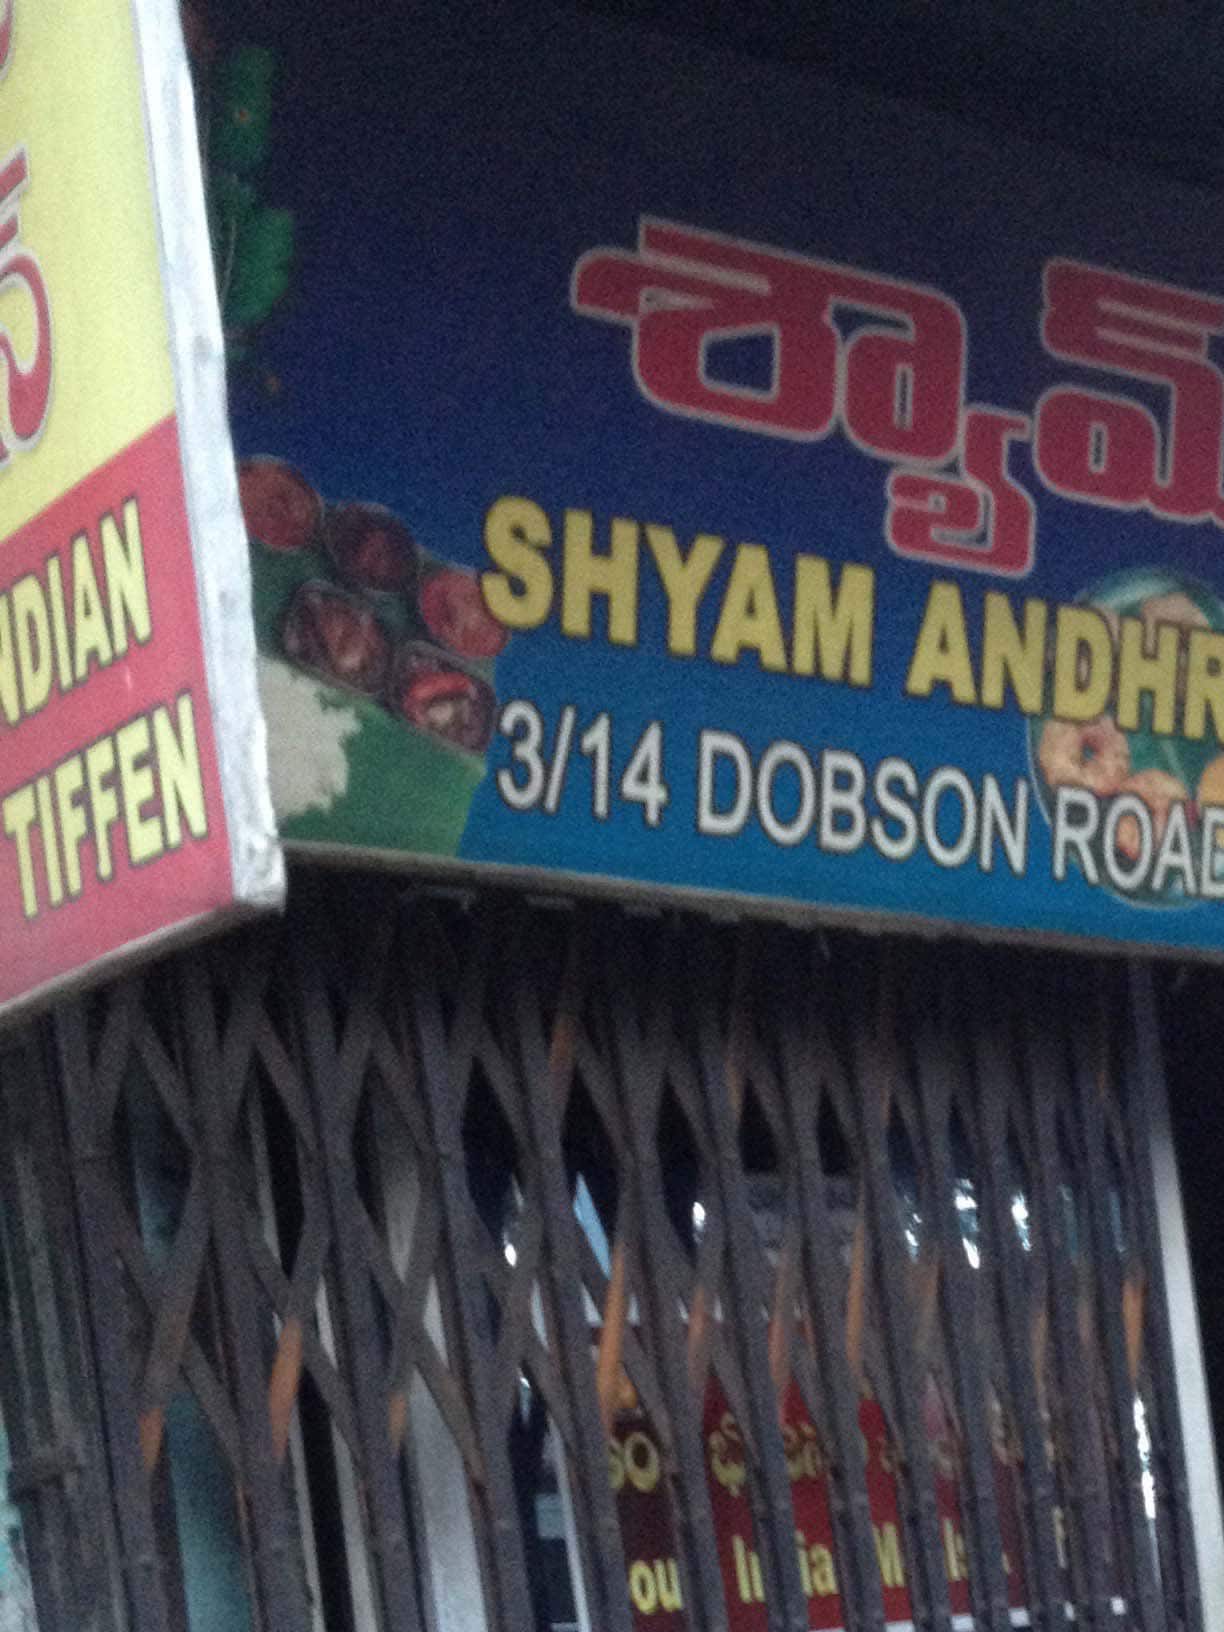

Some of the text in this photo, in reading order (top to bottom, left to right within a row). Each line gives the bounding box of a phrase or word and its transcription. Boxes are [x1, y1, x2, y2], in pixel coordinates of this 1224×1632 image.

[481, 496, 875, 688] SHYAM
[3, 691, 208, 919] TIFFEN
[497, 700, 668, 827] 3/14
[698, 729, 1030, 876] DOBSON
